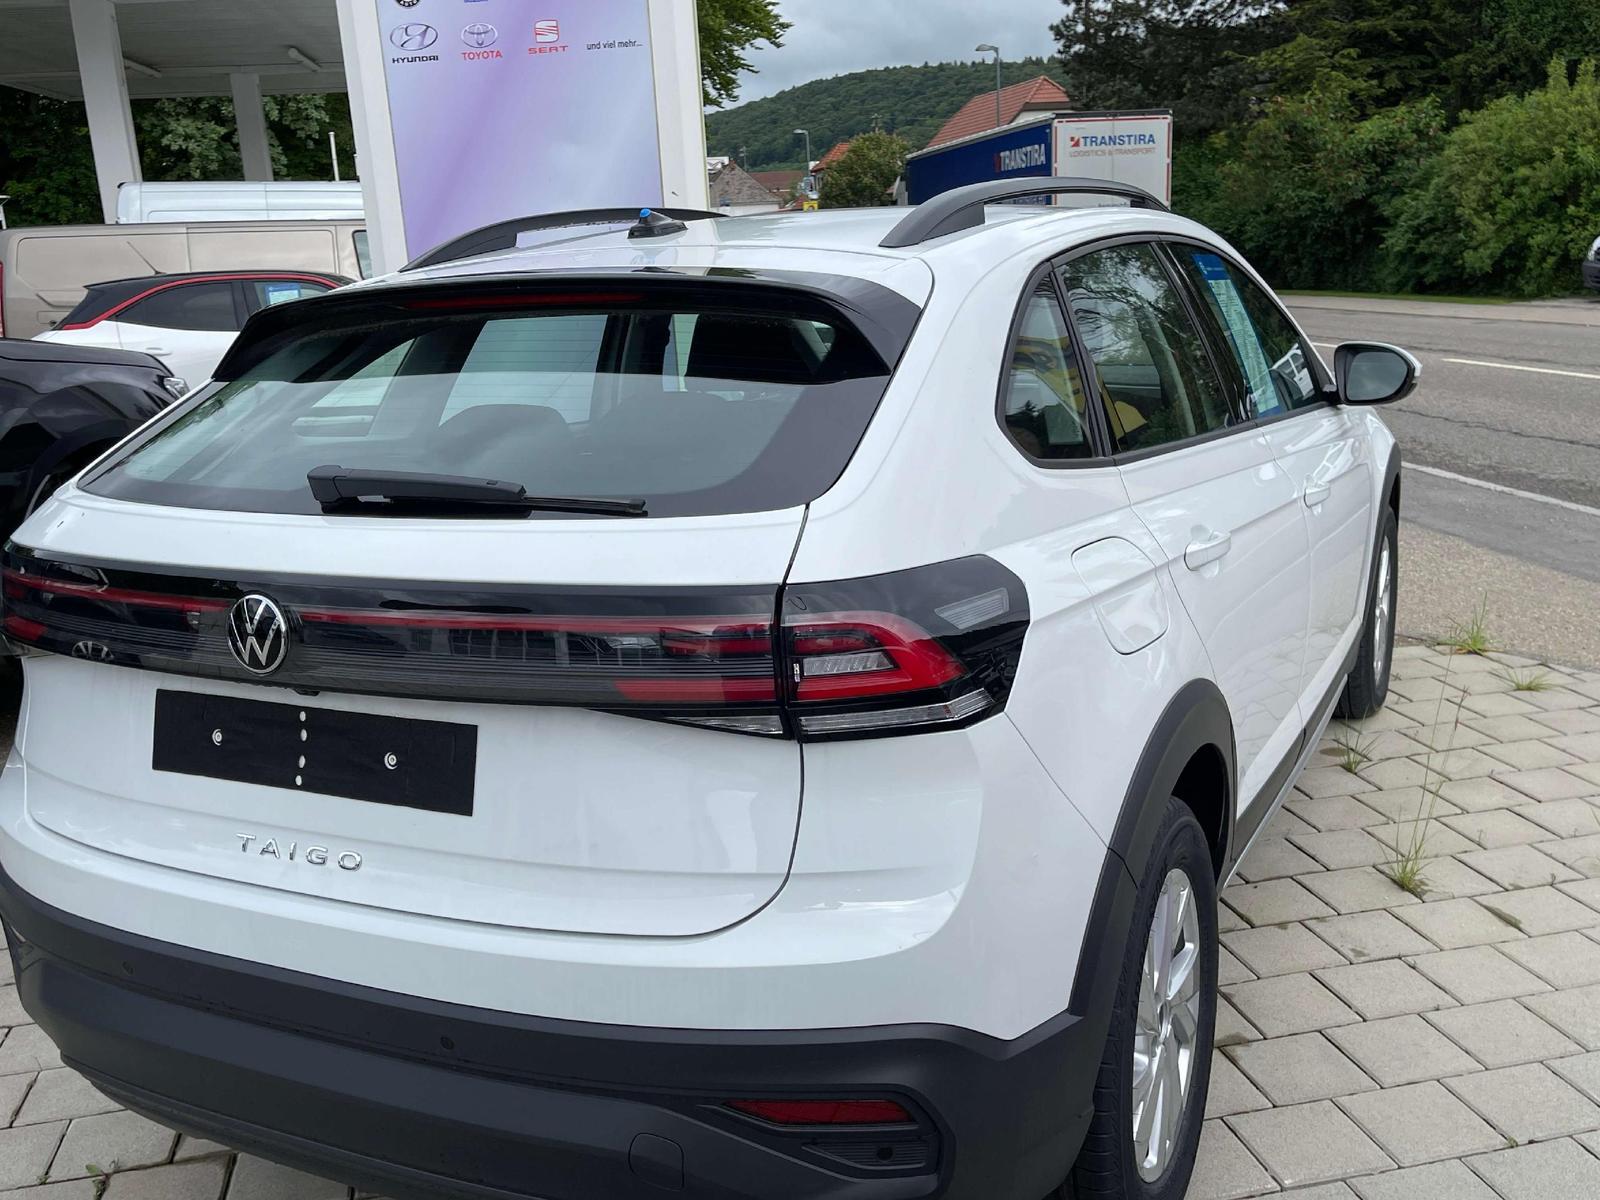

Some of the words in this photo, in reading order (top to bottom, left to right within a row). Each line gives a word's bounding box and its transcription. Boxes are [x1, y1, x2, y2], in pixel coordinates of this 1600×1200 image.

[528, 45, 568, 54] SEAT
[586, 41, 601, 50] und
[602, 40, 616, 49] viel
[392, 55, 439, 63] HYUNDAI
[461, 50, 502, 60] TOYOTA
[1081, 134, 1156, 147] TRANSTIRA
[1000, 144, 1046, 171] TRANSTIRA
[236, 833, 363, 872] TAIGO
